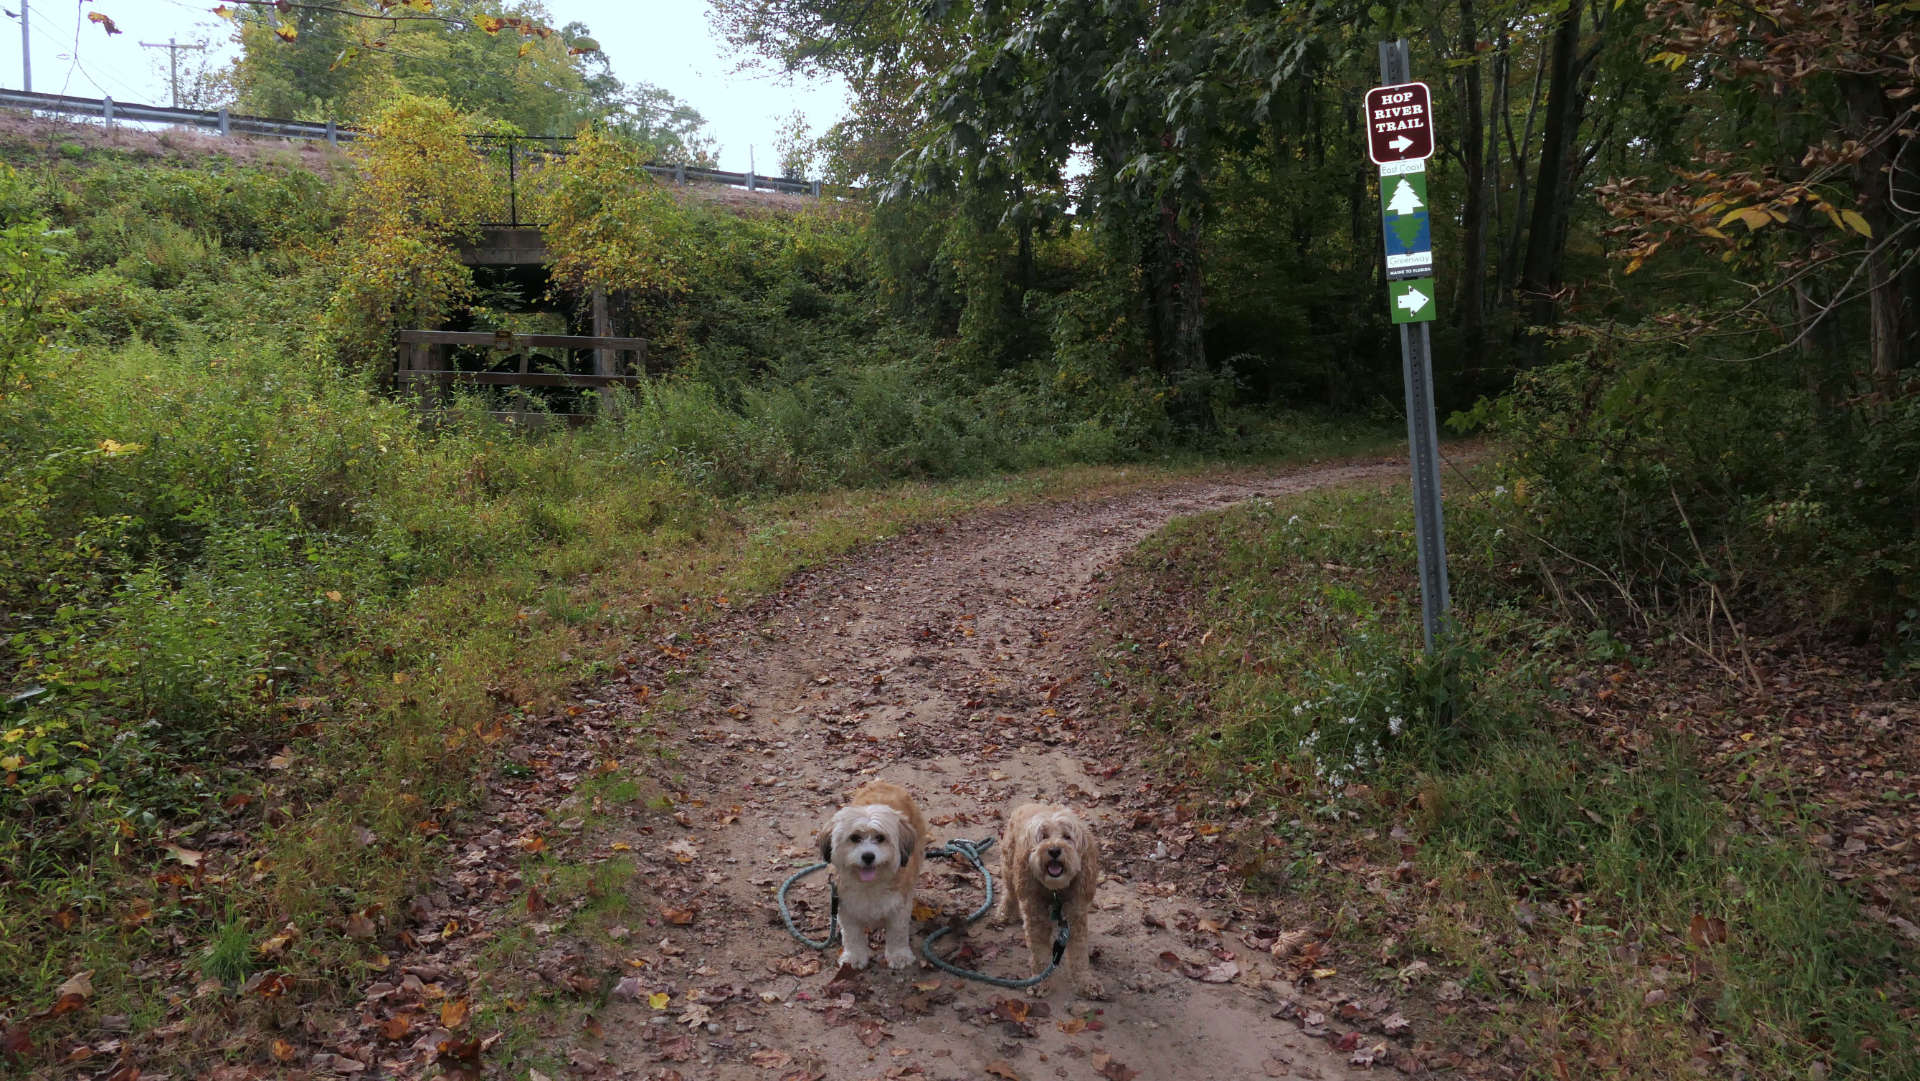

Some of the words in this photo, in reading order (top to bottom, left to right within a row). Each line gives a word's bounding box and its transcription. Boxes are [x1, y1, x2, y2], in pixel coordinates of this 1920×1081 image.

[1381, 92, 1413, 105] HOP
[1374, 105, 1423, 119] RIVER
[1376, 118, 1424, 132] TRAIL
